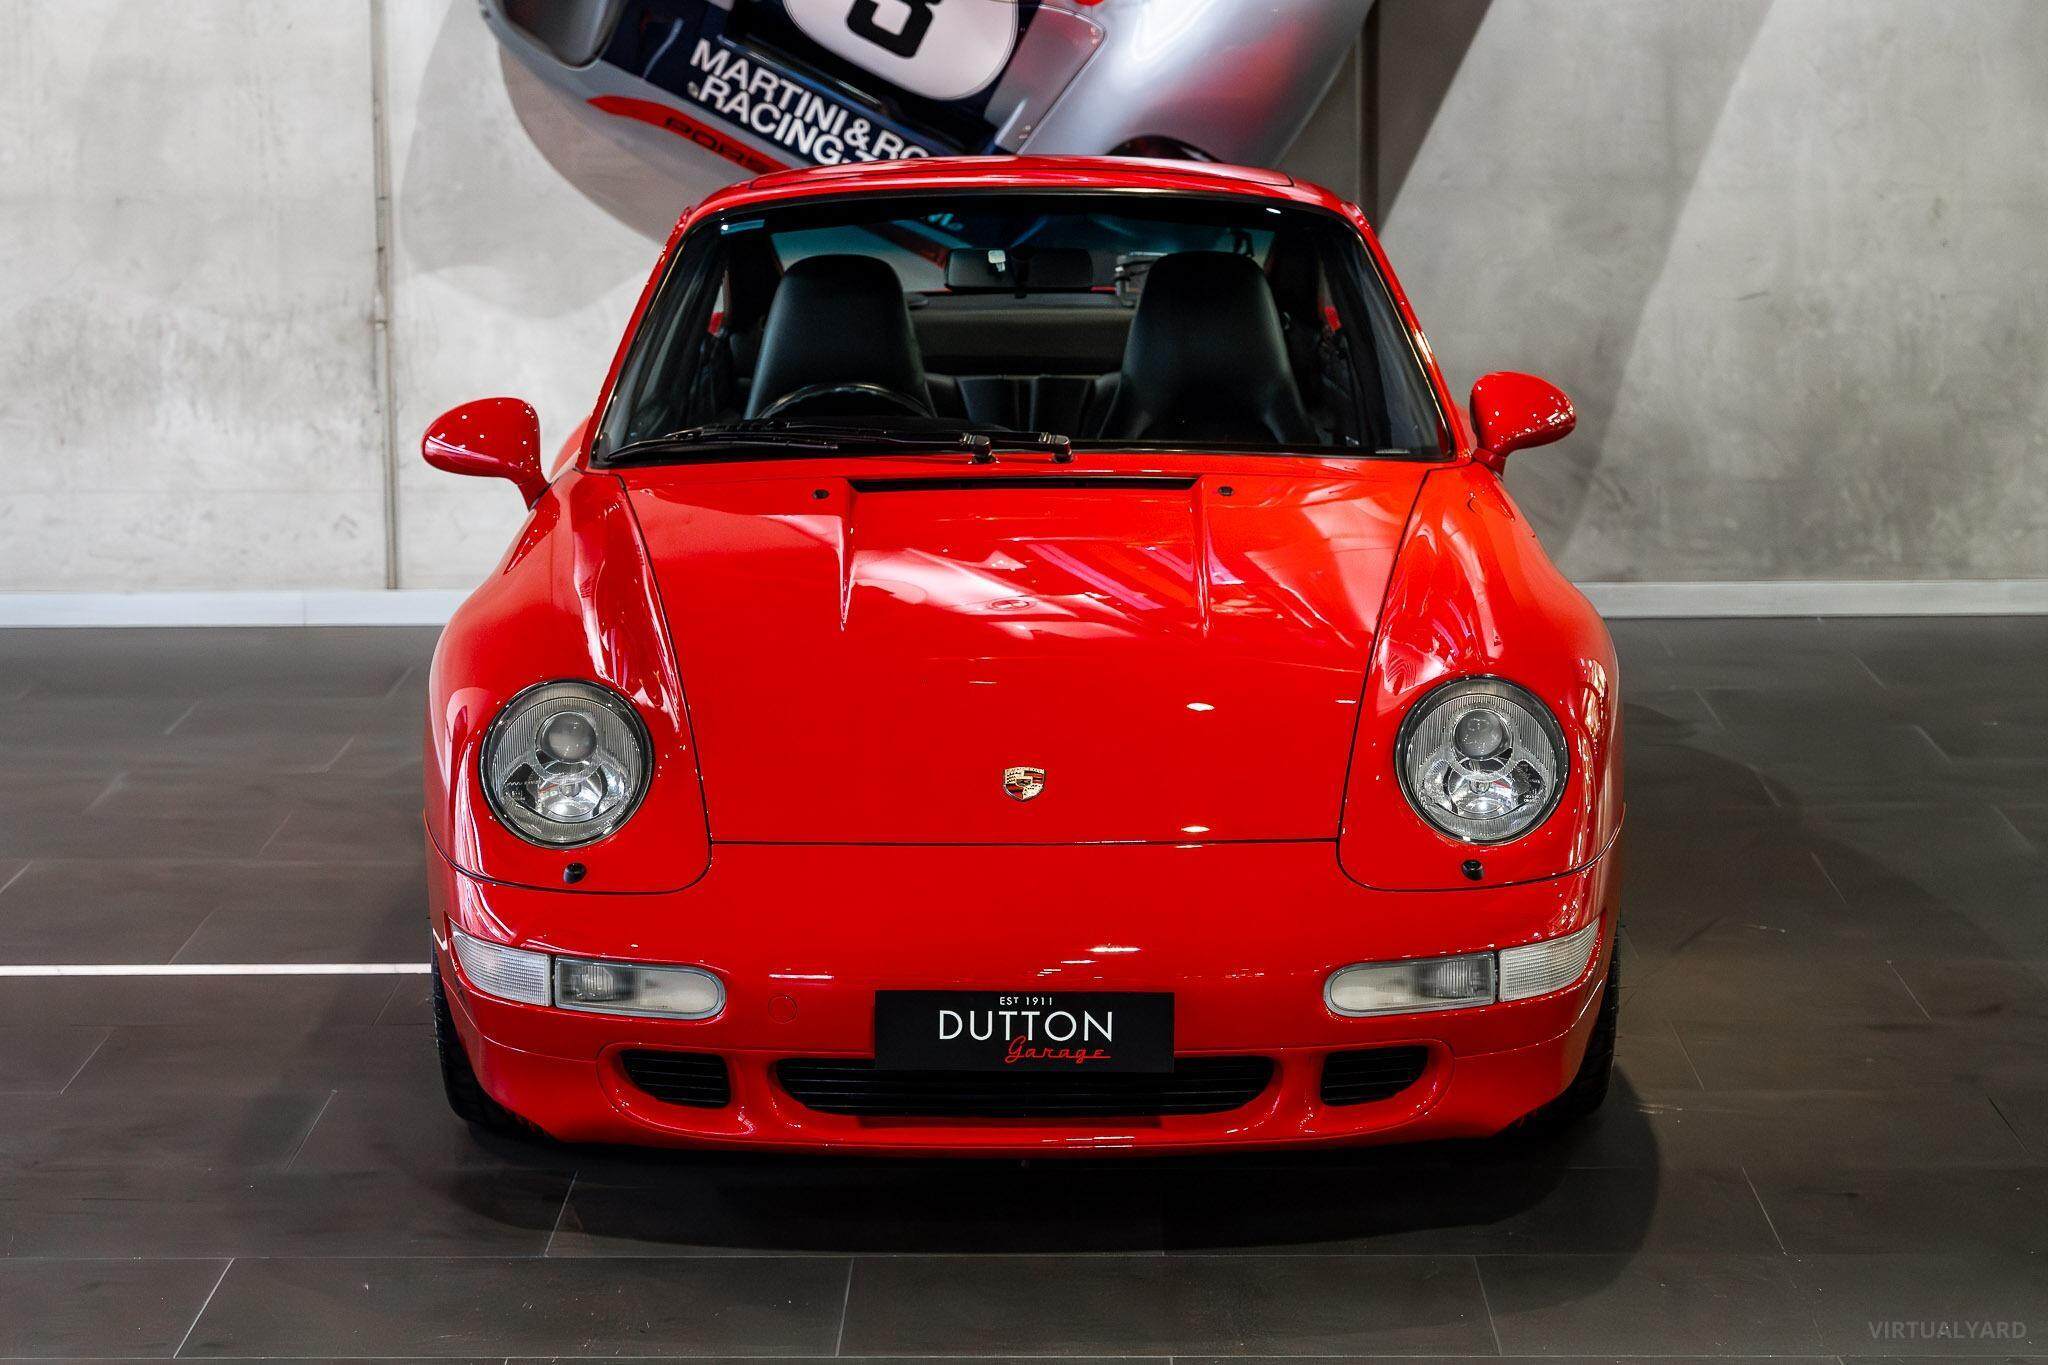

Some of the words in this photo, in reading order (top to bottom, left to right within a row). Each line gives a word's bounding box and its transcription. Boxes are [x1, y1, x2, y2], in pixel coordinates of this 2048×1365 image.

[999, 996, 1019, 1006] EST
[1026, 996, 1052, 1006] 1911
[939, 1010, 1112, 1042] DUTTON
[1004, 1036, 1111, 1064] Garage
